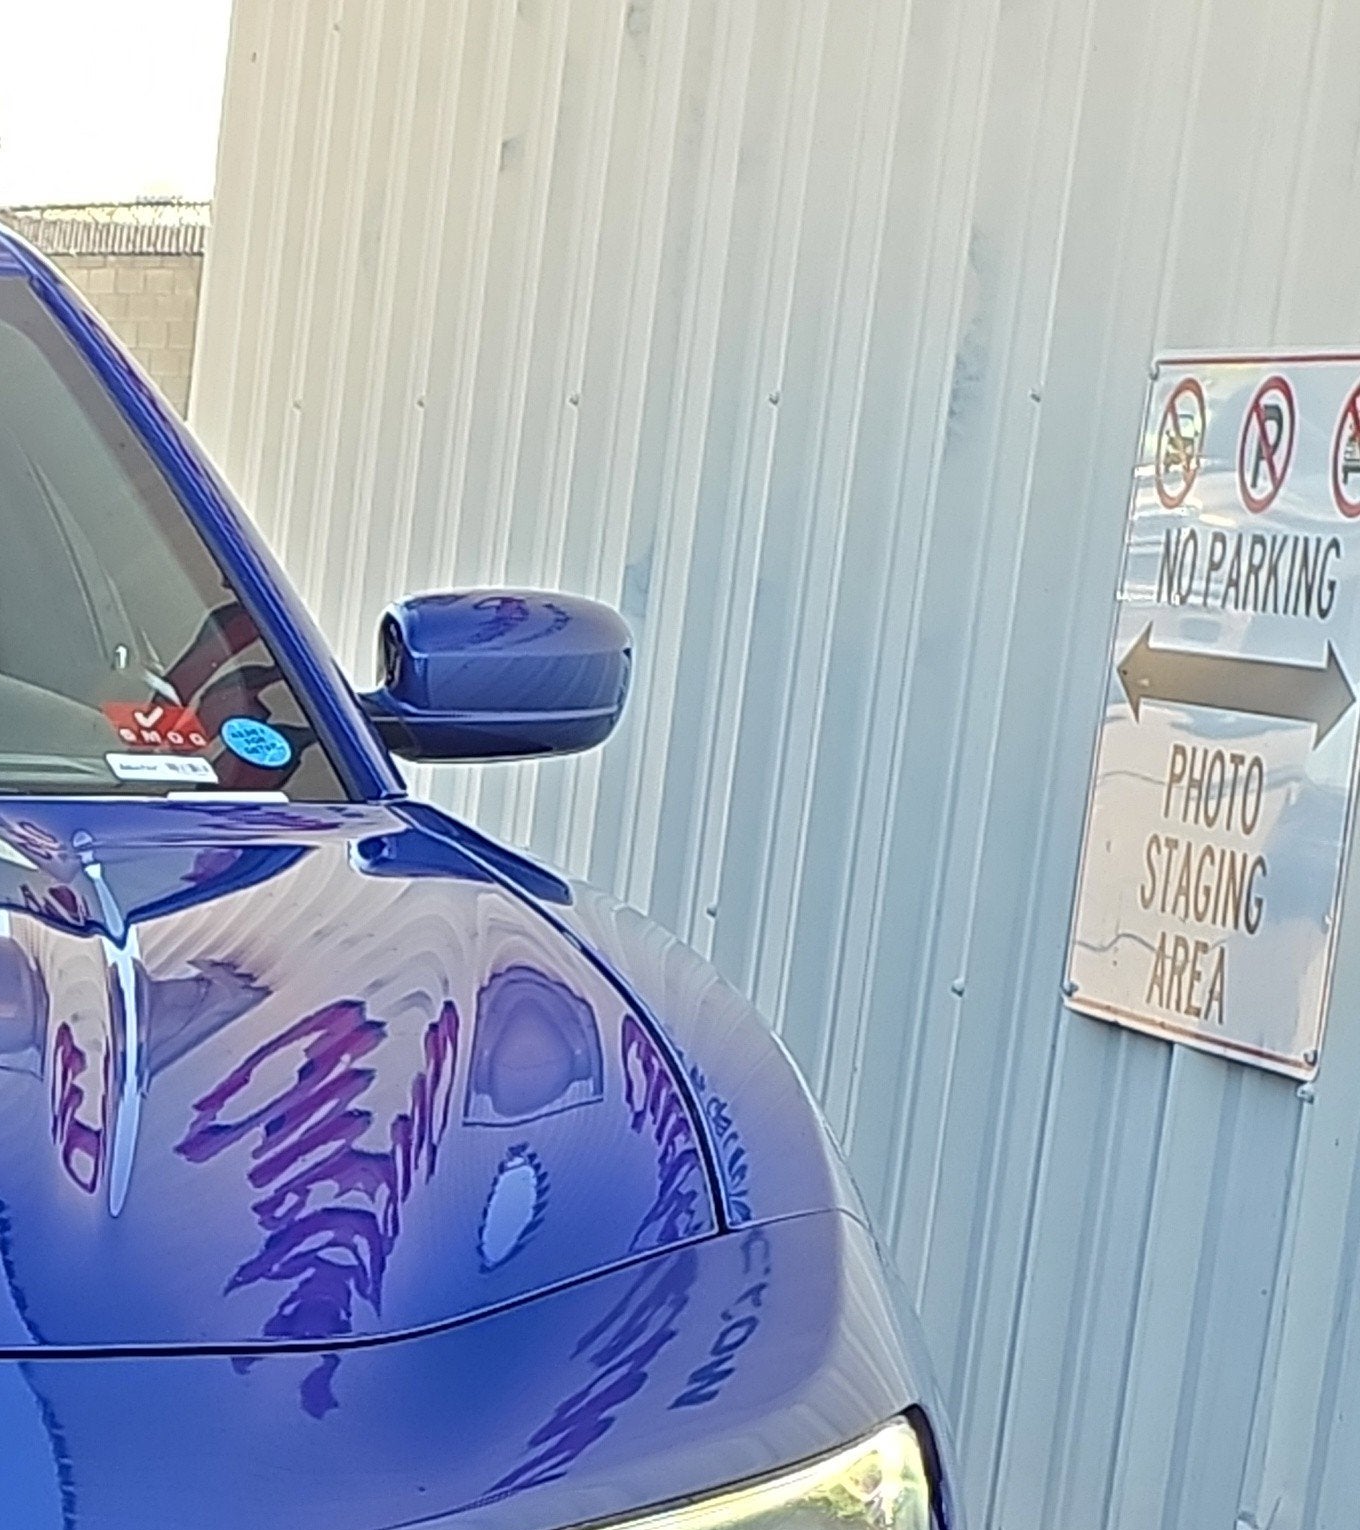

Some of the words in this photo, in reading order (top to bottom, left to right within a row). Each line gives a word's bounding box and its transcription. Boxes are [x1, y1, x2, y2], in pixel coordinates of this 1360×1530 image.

[1156, 527, 1198, 607] NO
[1202, 531, 1341, 620] PARKING
[1164, 743, 1264, 836] PHOTO
[1140, 833, 1268, 935] STAGING
[1145, 931, 1226, 1025] AREA
